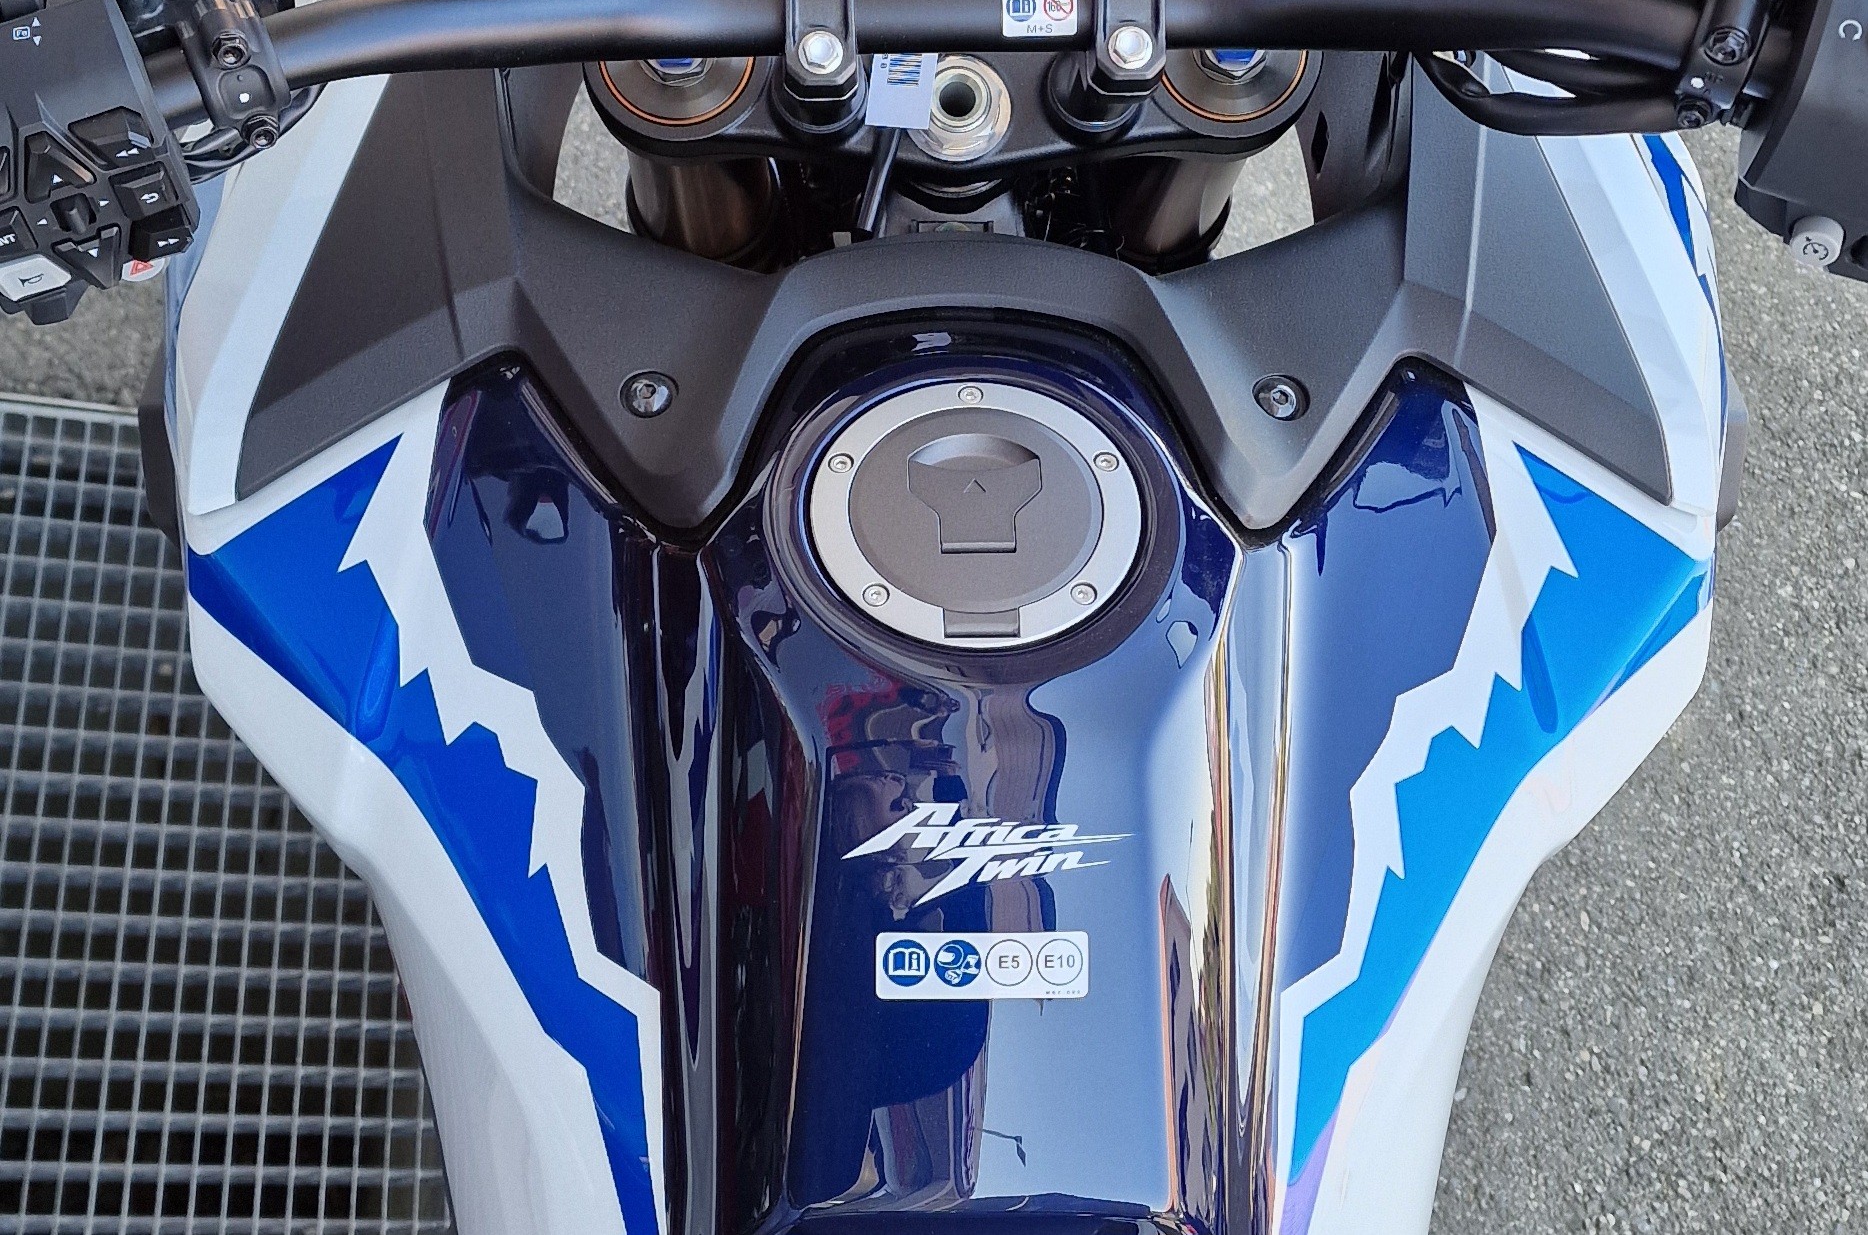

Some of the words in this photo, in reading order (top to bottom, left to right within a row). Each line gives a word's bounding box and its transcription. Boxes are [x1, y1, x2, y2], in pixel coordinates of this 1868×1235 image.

[840, 801, 1136, 862] Africa
[911, 837, 1124, 909] Twin
[998, 955, 1021, 970] E5
[1044, 954, 1076, 969] E10
